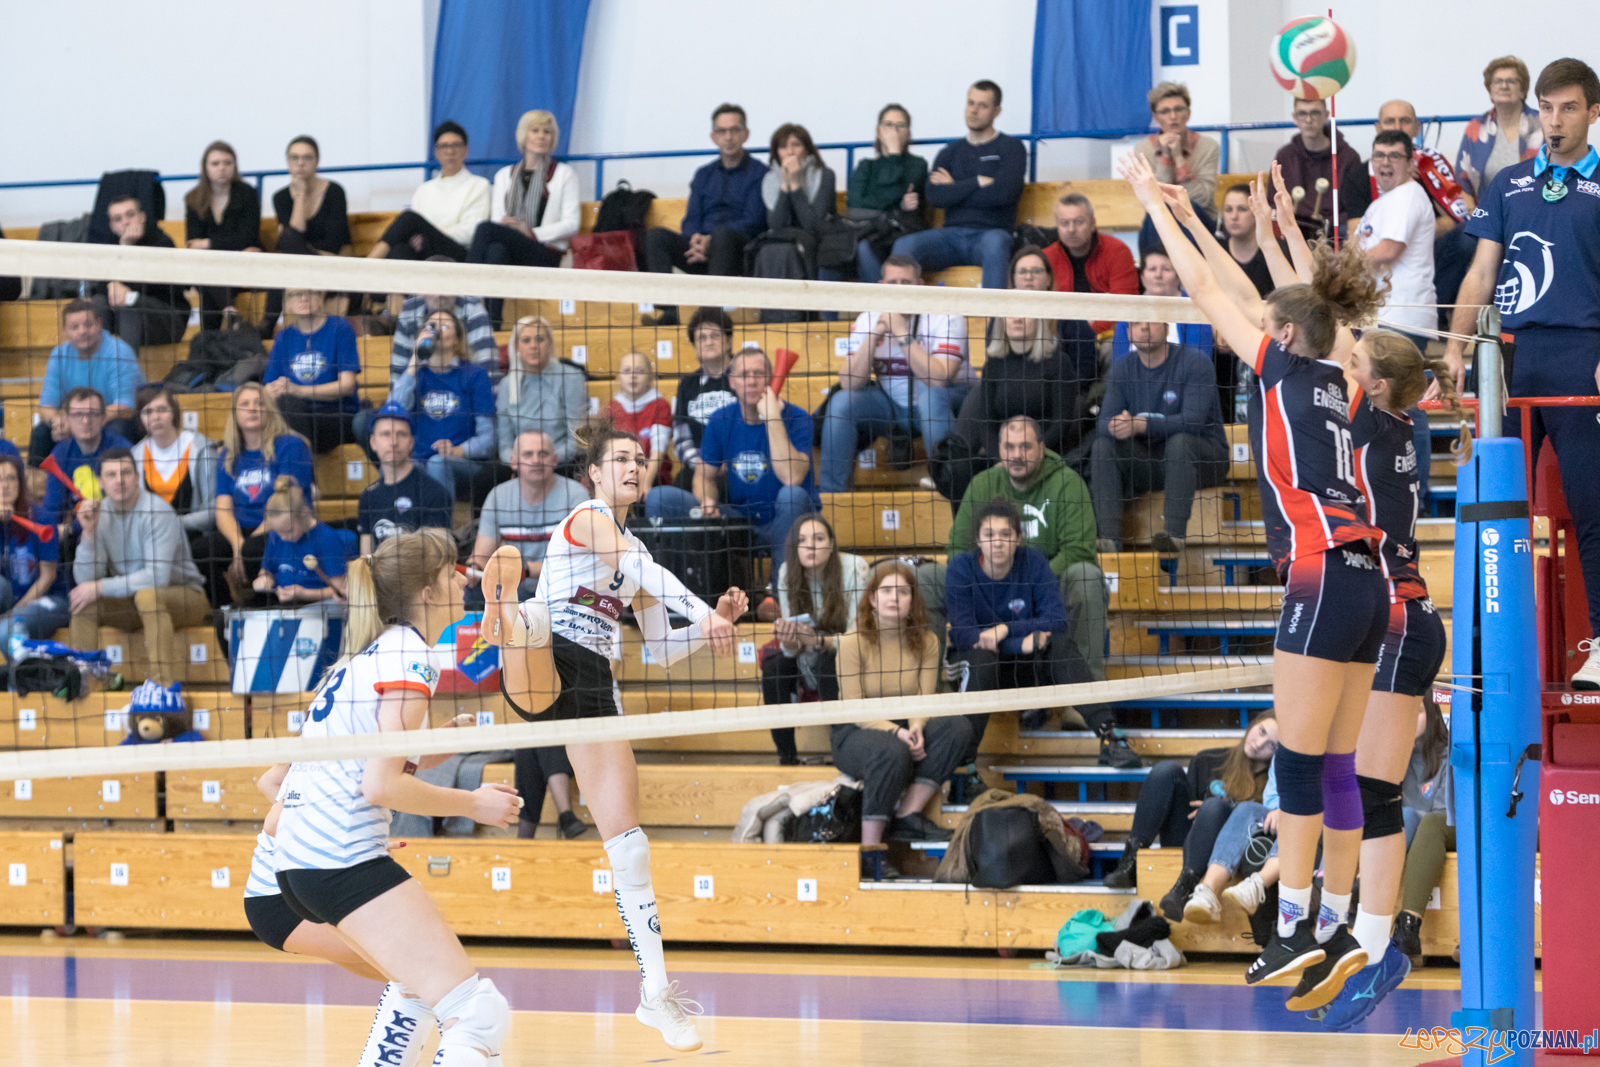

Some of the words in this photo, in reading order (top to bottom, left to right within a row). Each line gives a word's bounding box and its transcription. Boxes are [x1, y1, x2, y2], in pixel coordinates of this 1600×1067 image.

[1169, 15, 1191, 56] C
[1326, 420, 1355, 487] 10
[609, 570, 624, 591] 9
[1483, 548, 1500, 613] Senoh
[305, 667, 346, 722] 3
[207, 784, 216, 794] 16
[115, 866, 124, 876] 16
[216, 869, 226, 880] 15
[496, 871, 506, 882] 12
[598, 874, 608, 884] 11
[699, 879, 709, 890] 10
[804, 882, 810, 893] 9
